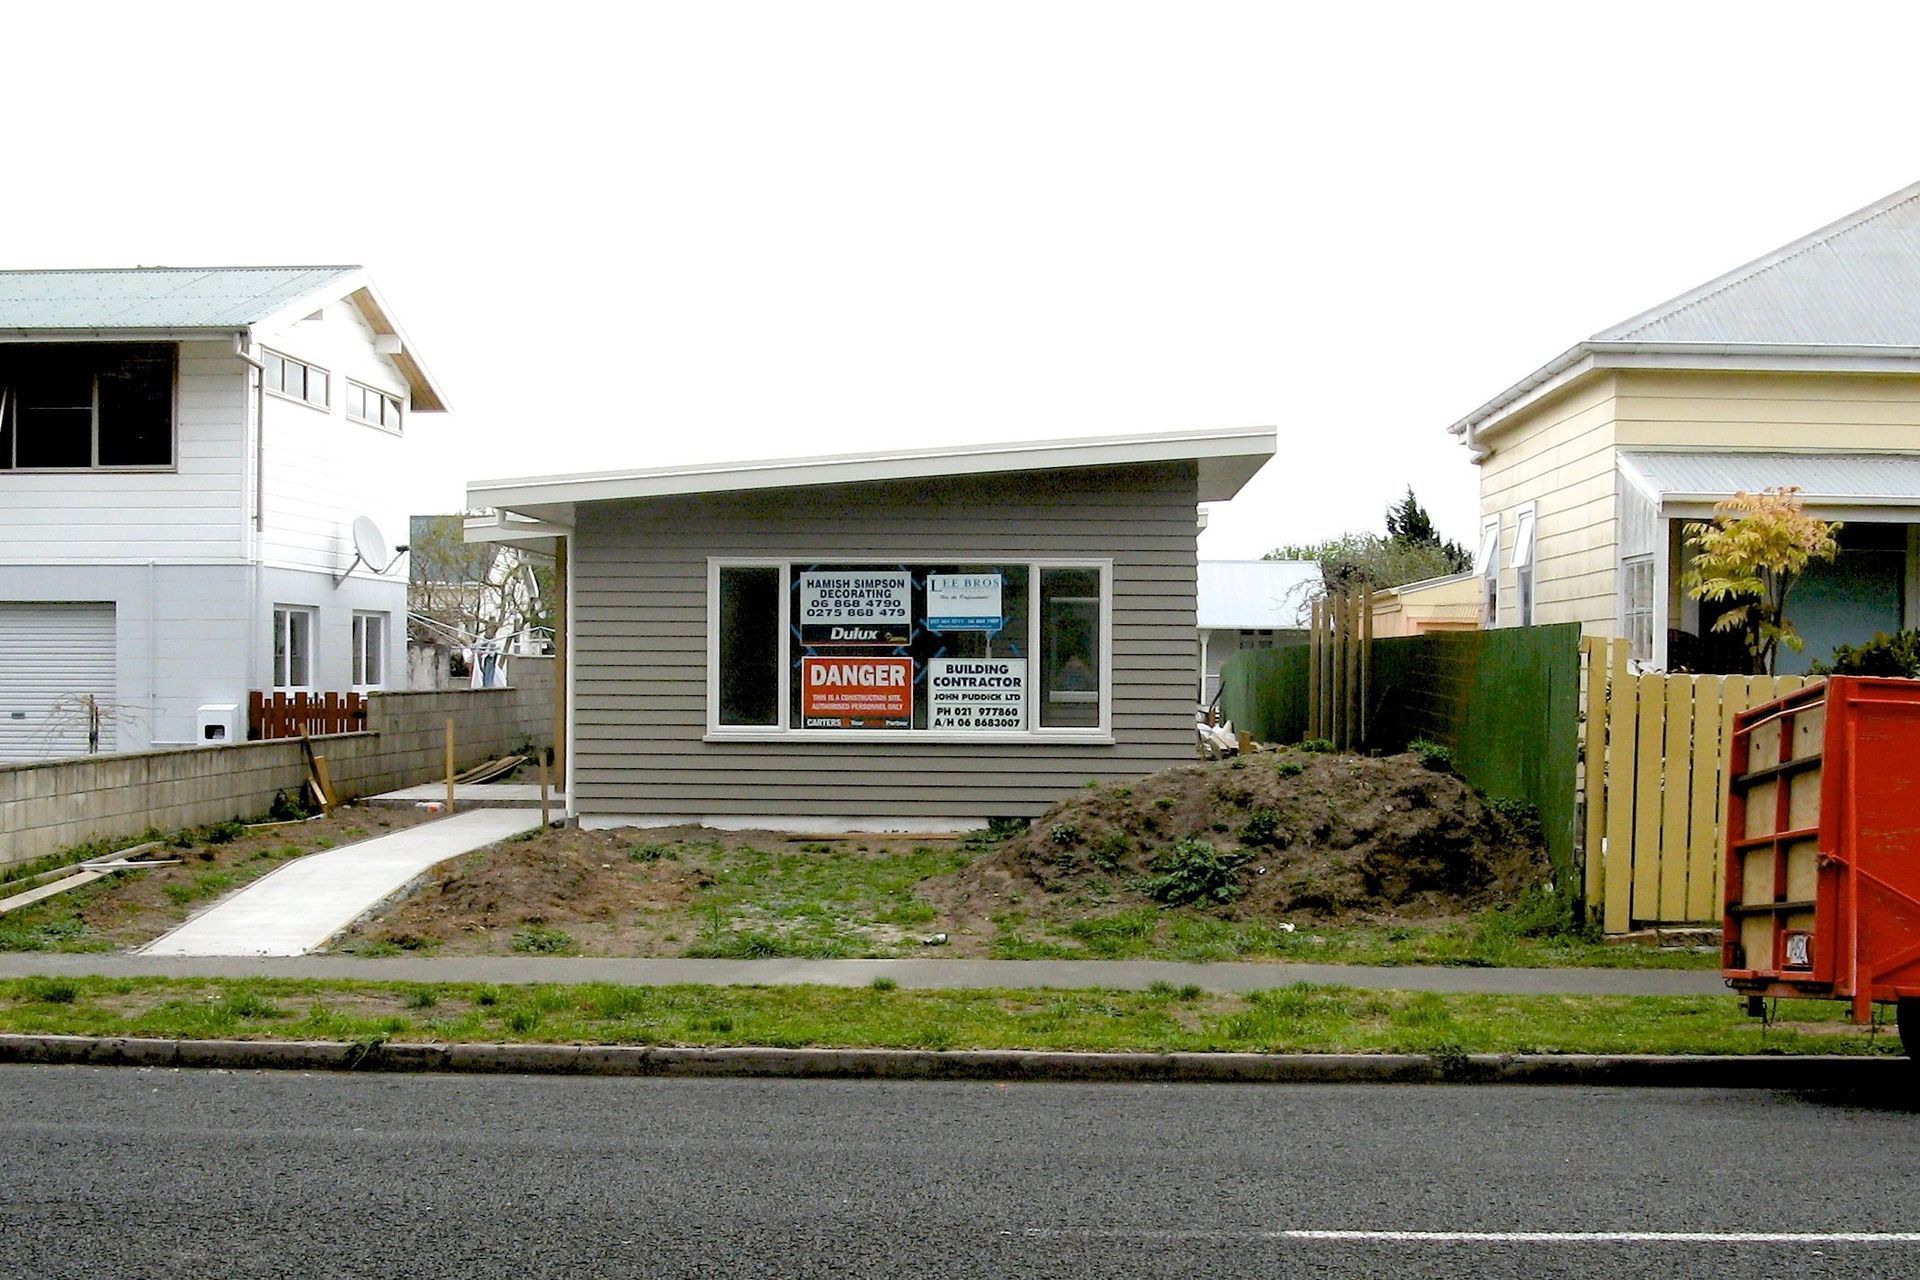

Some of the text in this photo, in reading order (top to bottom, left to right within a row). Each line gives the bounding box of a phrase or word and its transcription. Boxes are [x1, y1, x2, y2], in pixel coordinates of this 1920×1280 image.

[807, 579, 905, 588] HAMISH SIMPSON
[929, 579, 1000, 592] LEE BROS
[820, 589, 892, 598] DECORATING
[811, 599, 901, 608] 06 868 4790
[847, 608, 874, 617] 868
[879, 608, 906, 617] 479
[830, 627, 879, 640] Dulux
[946, 664, 1009, 674] BUILDING
[810, 664, 906, 687] DANGER
[933, 677, 1022, 687] CONTRACTOR
[812, 694, 827, 702] THIS
[840, 694, 887, 702] CONSTRUCTION
[934, 693, 1021, 701] JOHN PUDDICK LTD
[850, 703, 887, 711] PERSONNEL
[887, 703, 904, 711] ONLY
[937, 707, 1018, 716] PH 021 977860
[807, 718, 842, 727] CARTERS
[934, 718, 1020, 727] A/H 06 8683007
